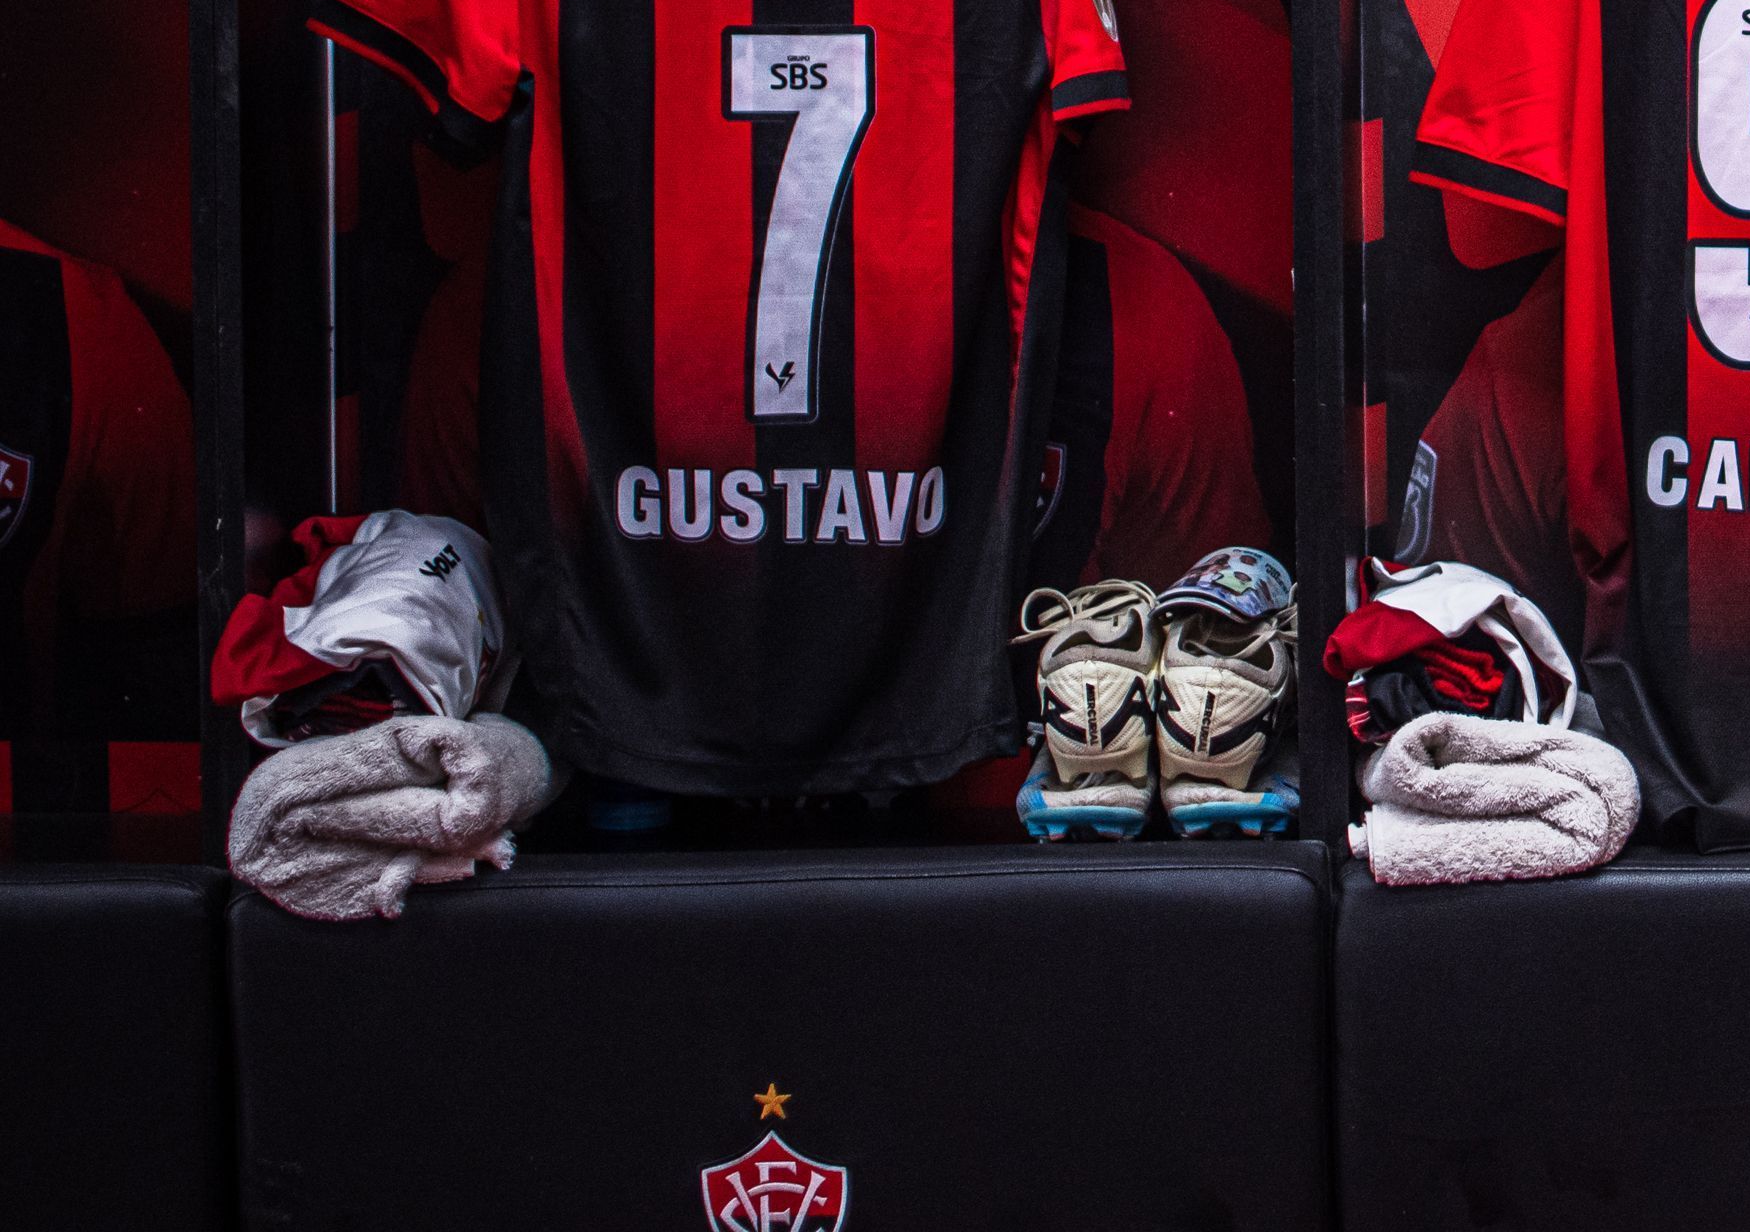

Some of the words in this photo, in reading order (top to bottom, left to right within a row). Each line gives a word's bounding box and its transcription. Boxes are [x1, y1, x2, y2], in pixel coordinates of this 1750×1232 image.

[770, 63, 828, 90] SBS
[727, 30, 871, 420] 7
[615, 465, 945, 545] GUSTAVO
